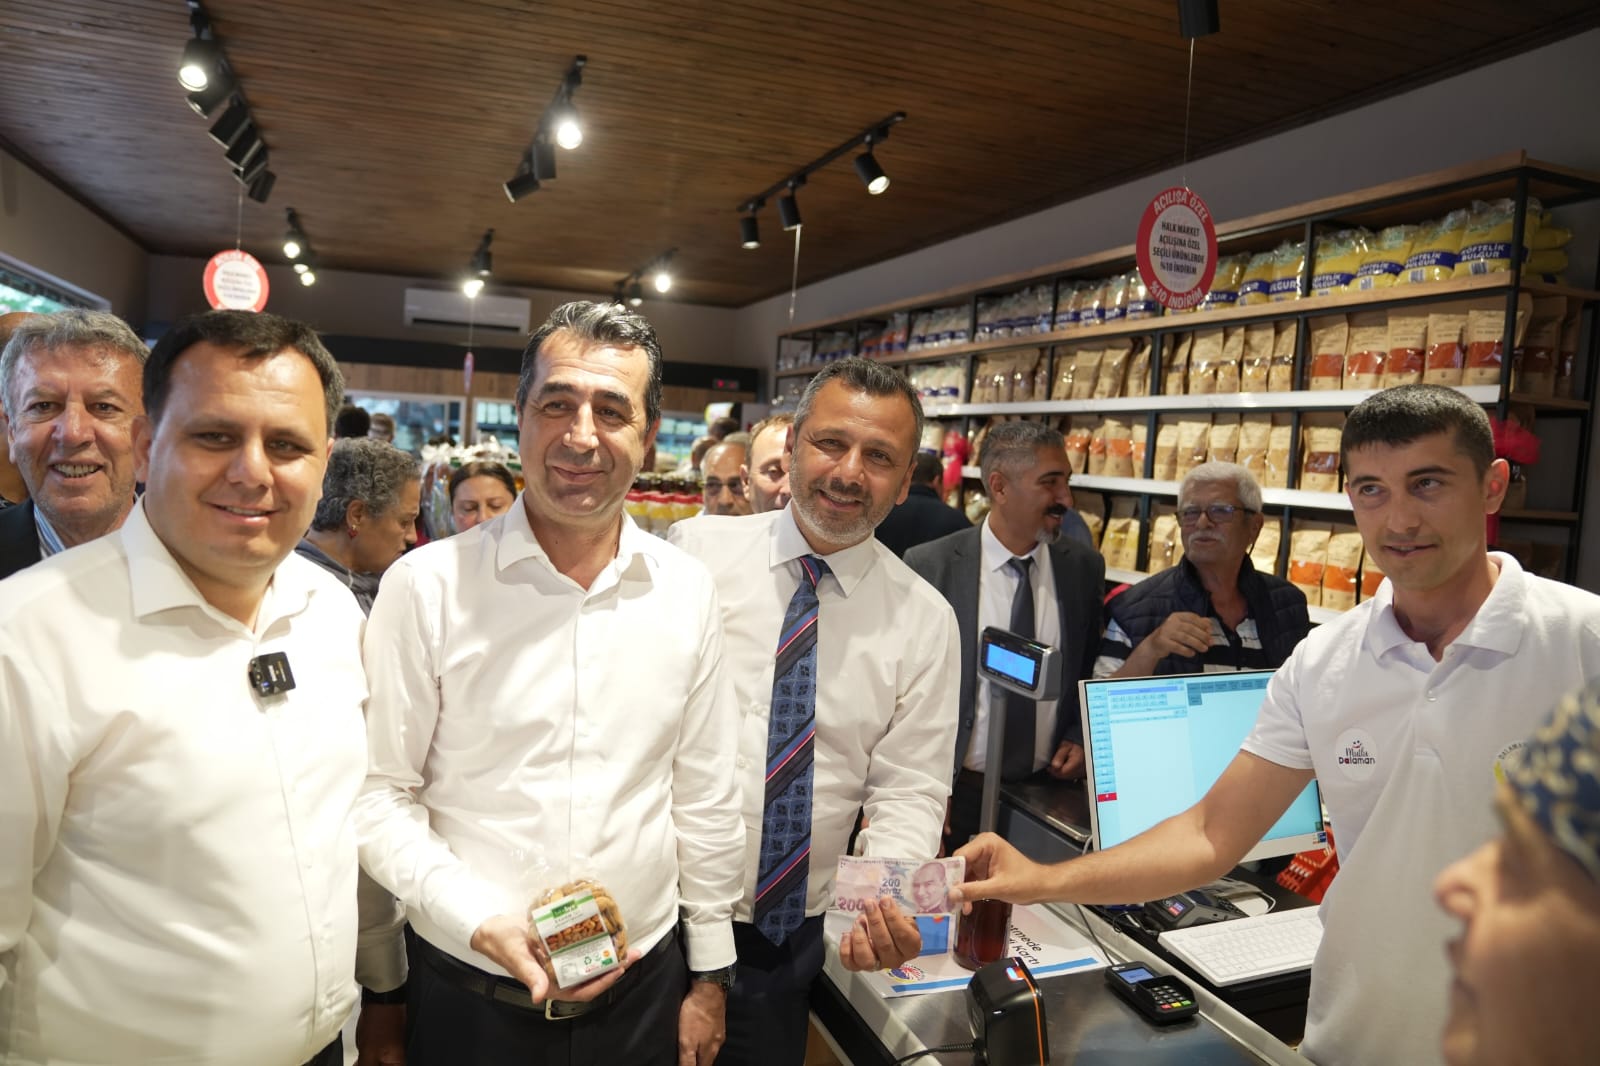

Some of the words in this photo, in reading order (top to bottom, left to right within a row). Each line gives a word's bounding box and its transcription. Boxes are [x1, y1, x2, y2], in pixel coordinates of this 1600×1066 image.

[1153, 190, 1188, 215] AÇILIŞA
[1189, 194, 1210, 222] ÖZEL
[1161, 221, 1177, 233] HALK
[1177, 224, 1201, 237] MARKET
[1159, 234, 1187, 248] AÇILIŞINA
[1187, 236, 1201, 249] ÖZEL
[1152, 246, 1172, 258] SEÇİLİ
[1173, 260, 1197, 275] İNDİRİM
[1149, 280, 1168, 301] %10
[1168, 287, 1204, 308] İNDİRİM
[1338, 757, 1376, 765] Dalaman
[882, 879, 900, 887] 200
[838, 896, 865, 912] 200
